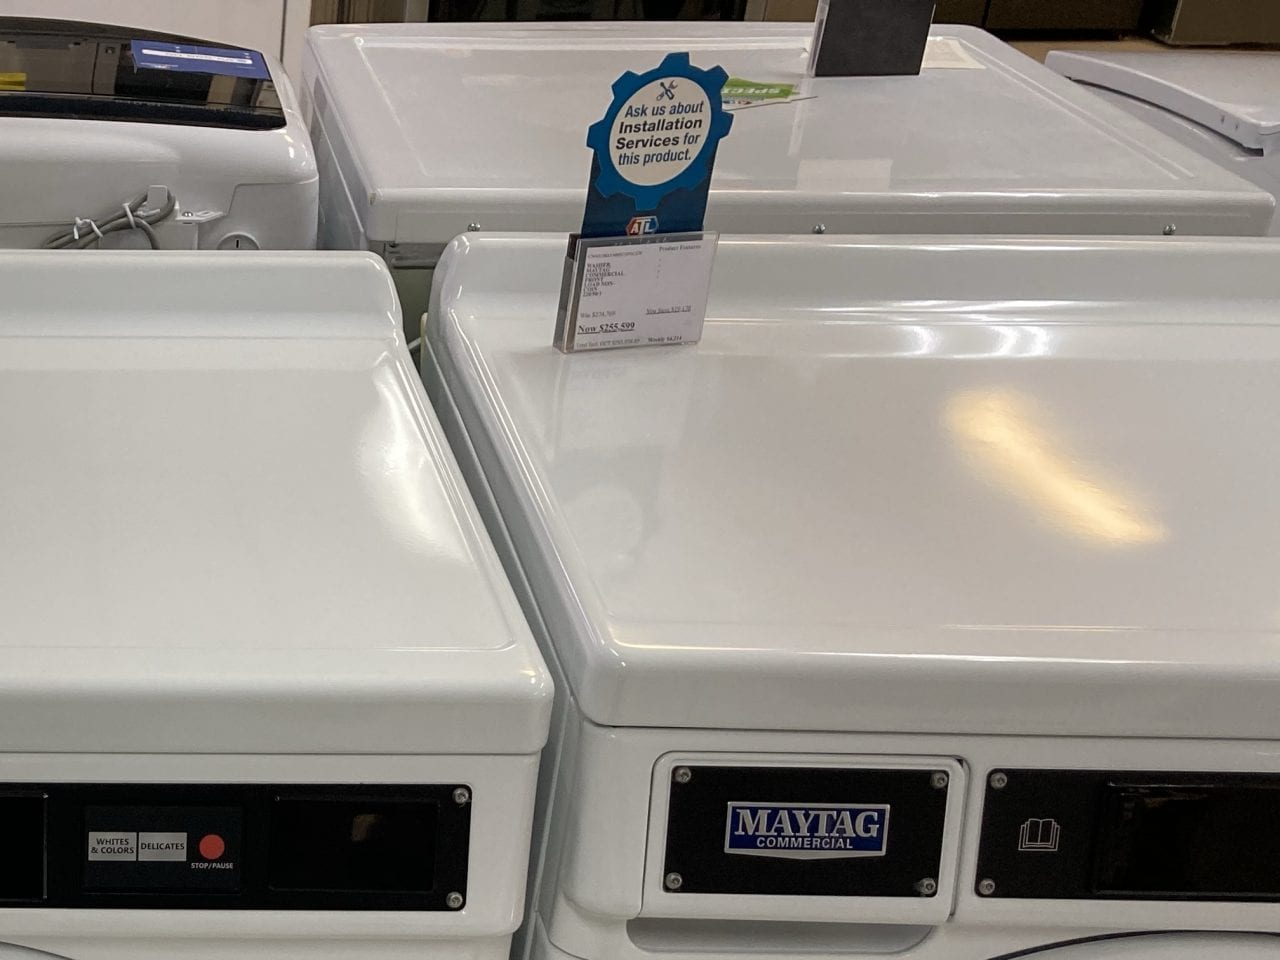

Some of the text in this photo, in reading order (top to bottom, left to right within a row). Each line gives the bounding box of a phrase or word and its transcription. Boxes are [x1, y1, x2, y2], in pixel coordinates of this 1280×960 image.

[625, 101, 704, 118] Ask us about
[619, 118, 702, 134] Installation
[616, 133, 701, 150] Services for
[618, 149, 691, 166] this product.
[629, 218, 655, 235] ATL
[577, 322, 635, 335] Now $255,599
[734, 808, 880, 838] MAYTAG
[96, 838, 129, 846] WHITES
[756, 837, 853, 849] COMMERCIAL
